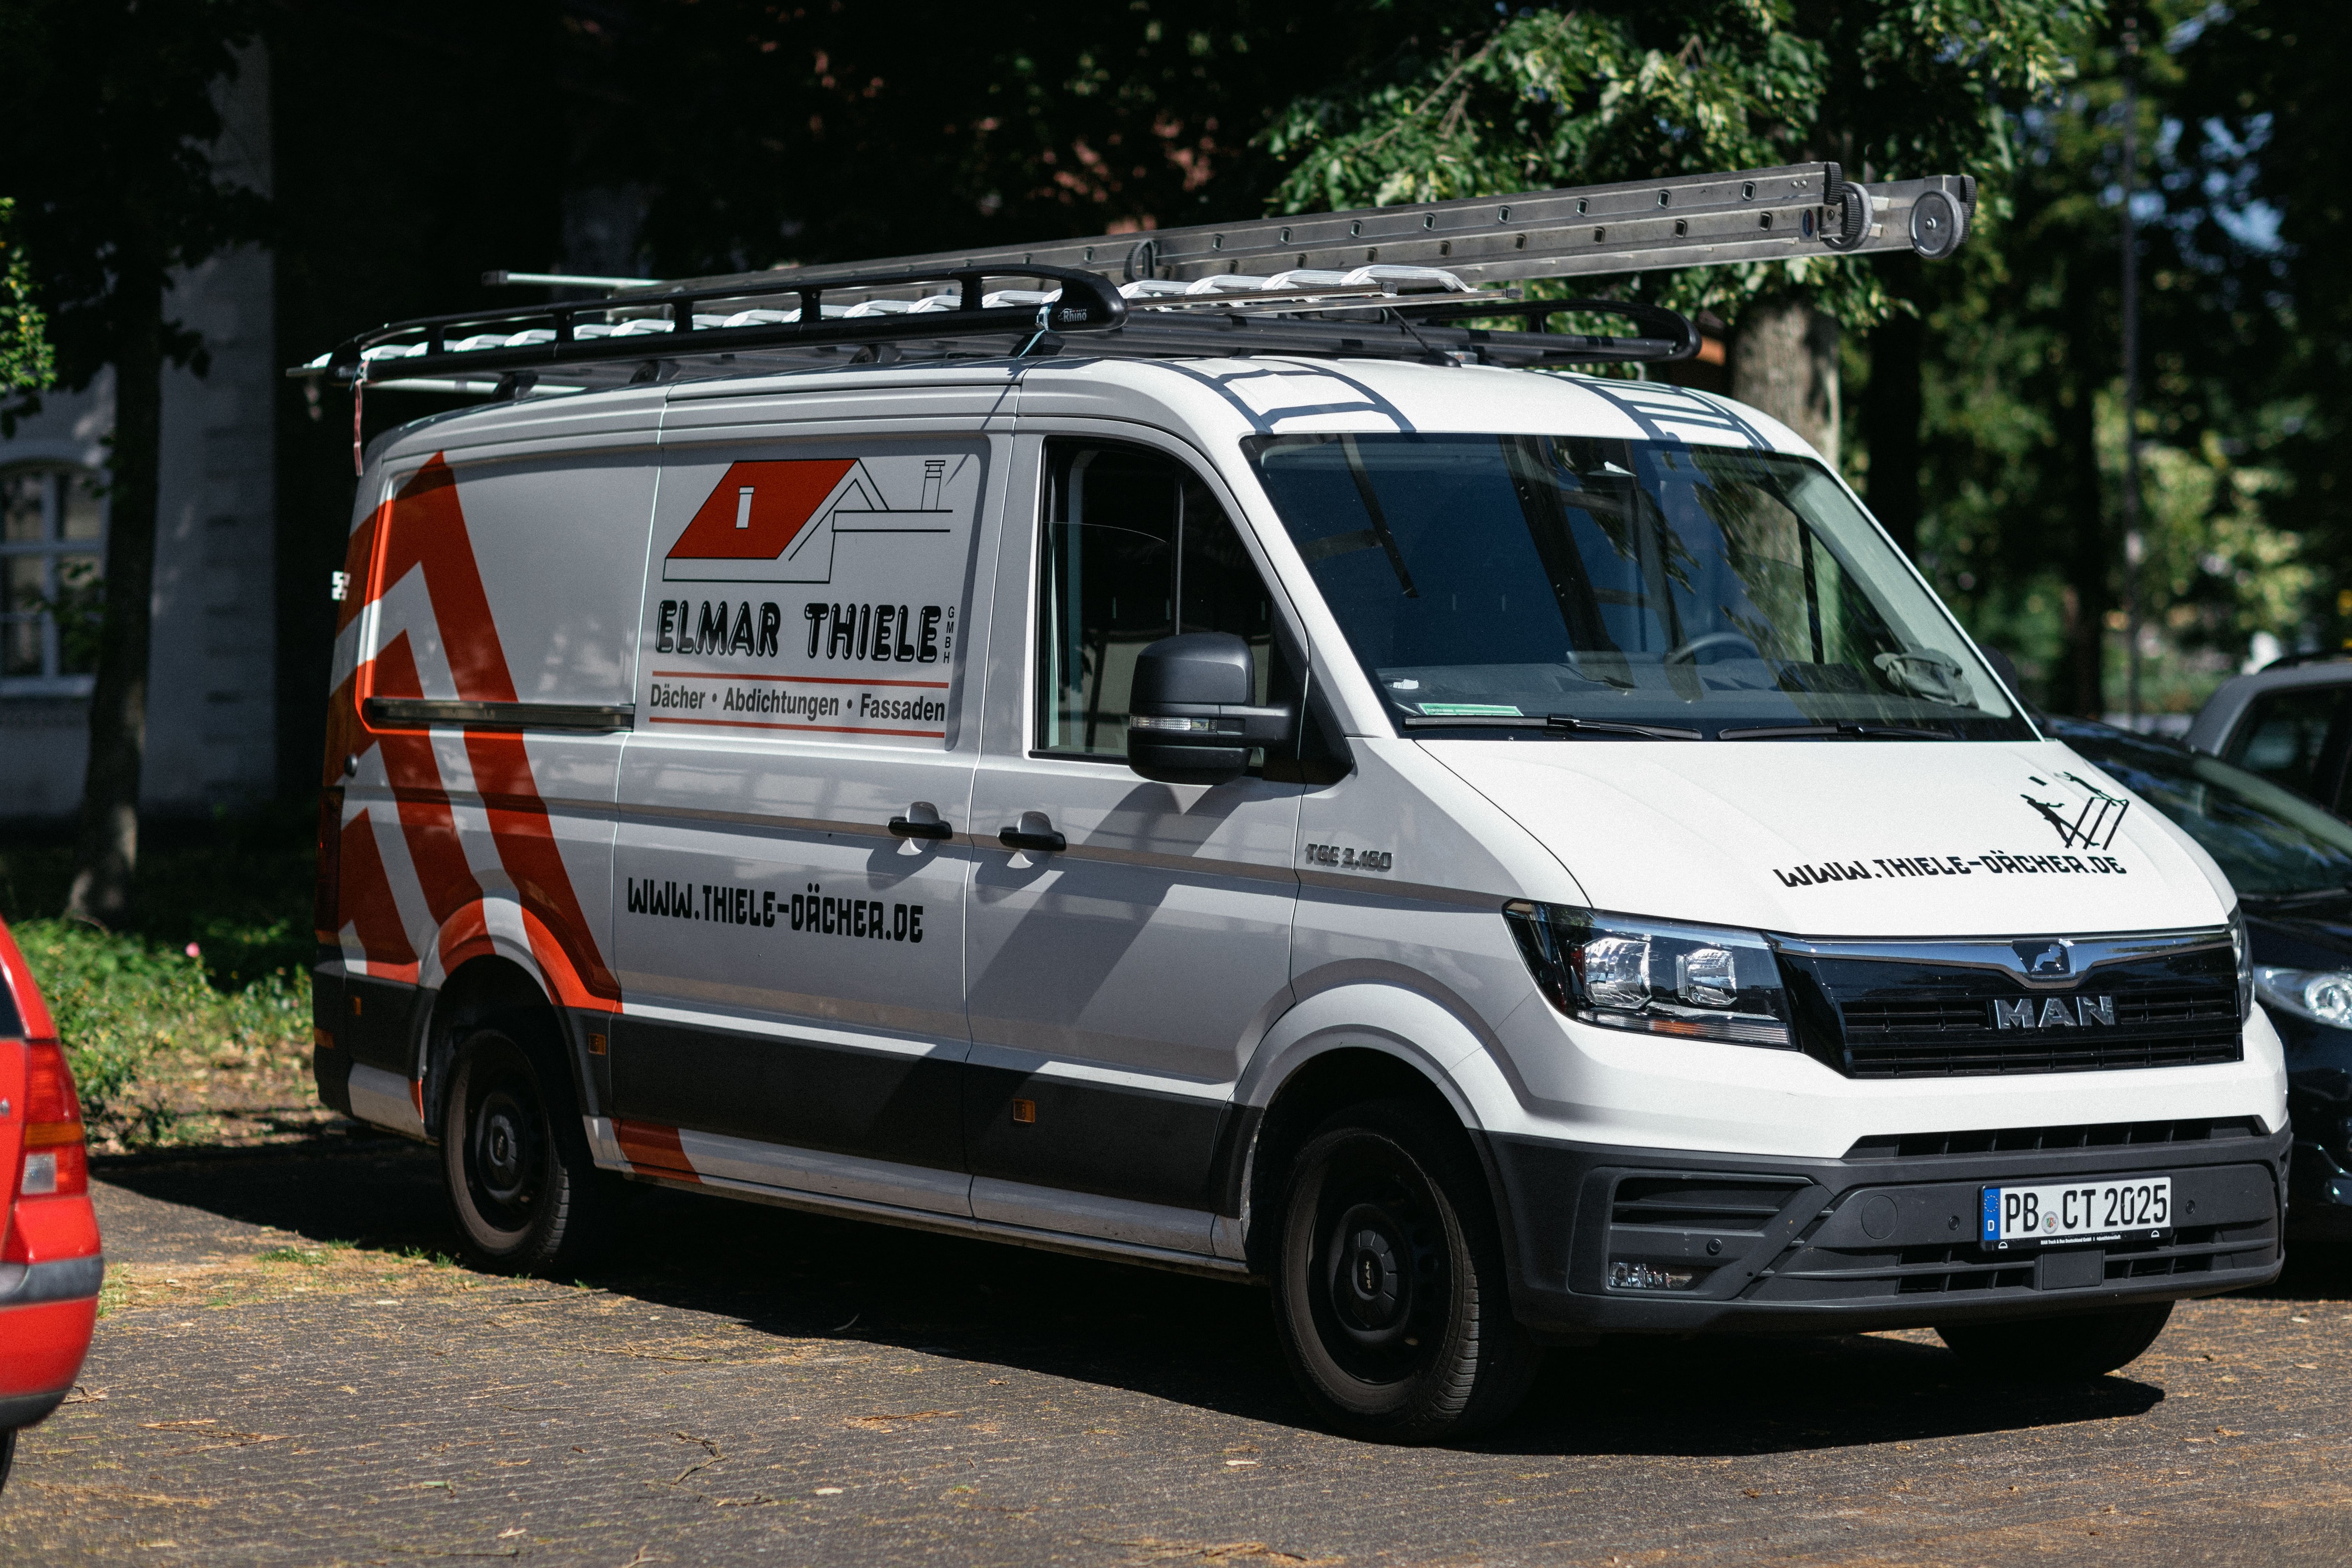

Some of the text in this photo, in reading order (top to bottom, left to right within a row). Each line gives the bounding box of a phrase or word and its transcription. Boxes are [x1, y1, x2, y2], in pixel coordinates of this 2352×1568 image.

[1064, 310, 1087, 322] Rhino
[655, 600, 941, 663] ELMAR THIELE
[651, 684, 945, 721] Dächer Abdichtungen Fassaden
[1305, 844, 1393, 870] TGE 3.160
[1773, 850, 2127, 888] WWW.THIELE-DÄCHER.DE
[628, 877, 923, 943] WWW.THIELE-DÄCHER.DE
[1994, 995, 2115, 1030] MAN
[1988, 1220, 1994, 1231] D
[2005, 1193, 2039, 1233] PB
[2062, 1189, 2096, 1229] CT
[2104, 1184, 2167, 1226] 2025
